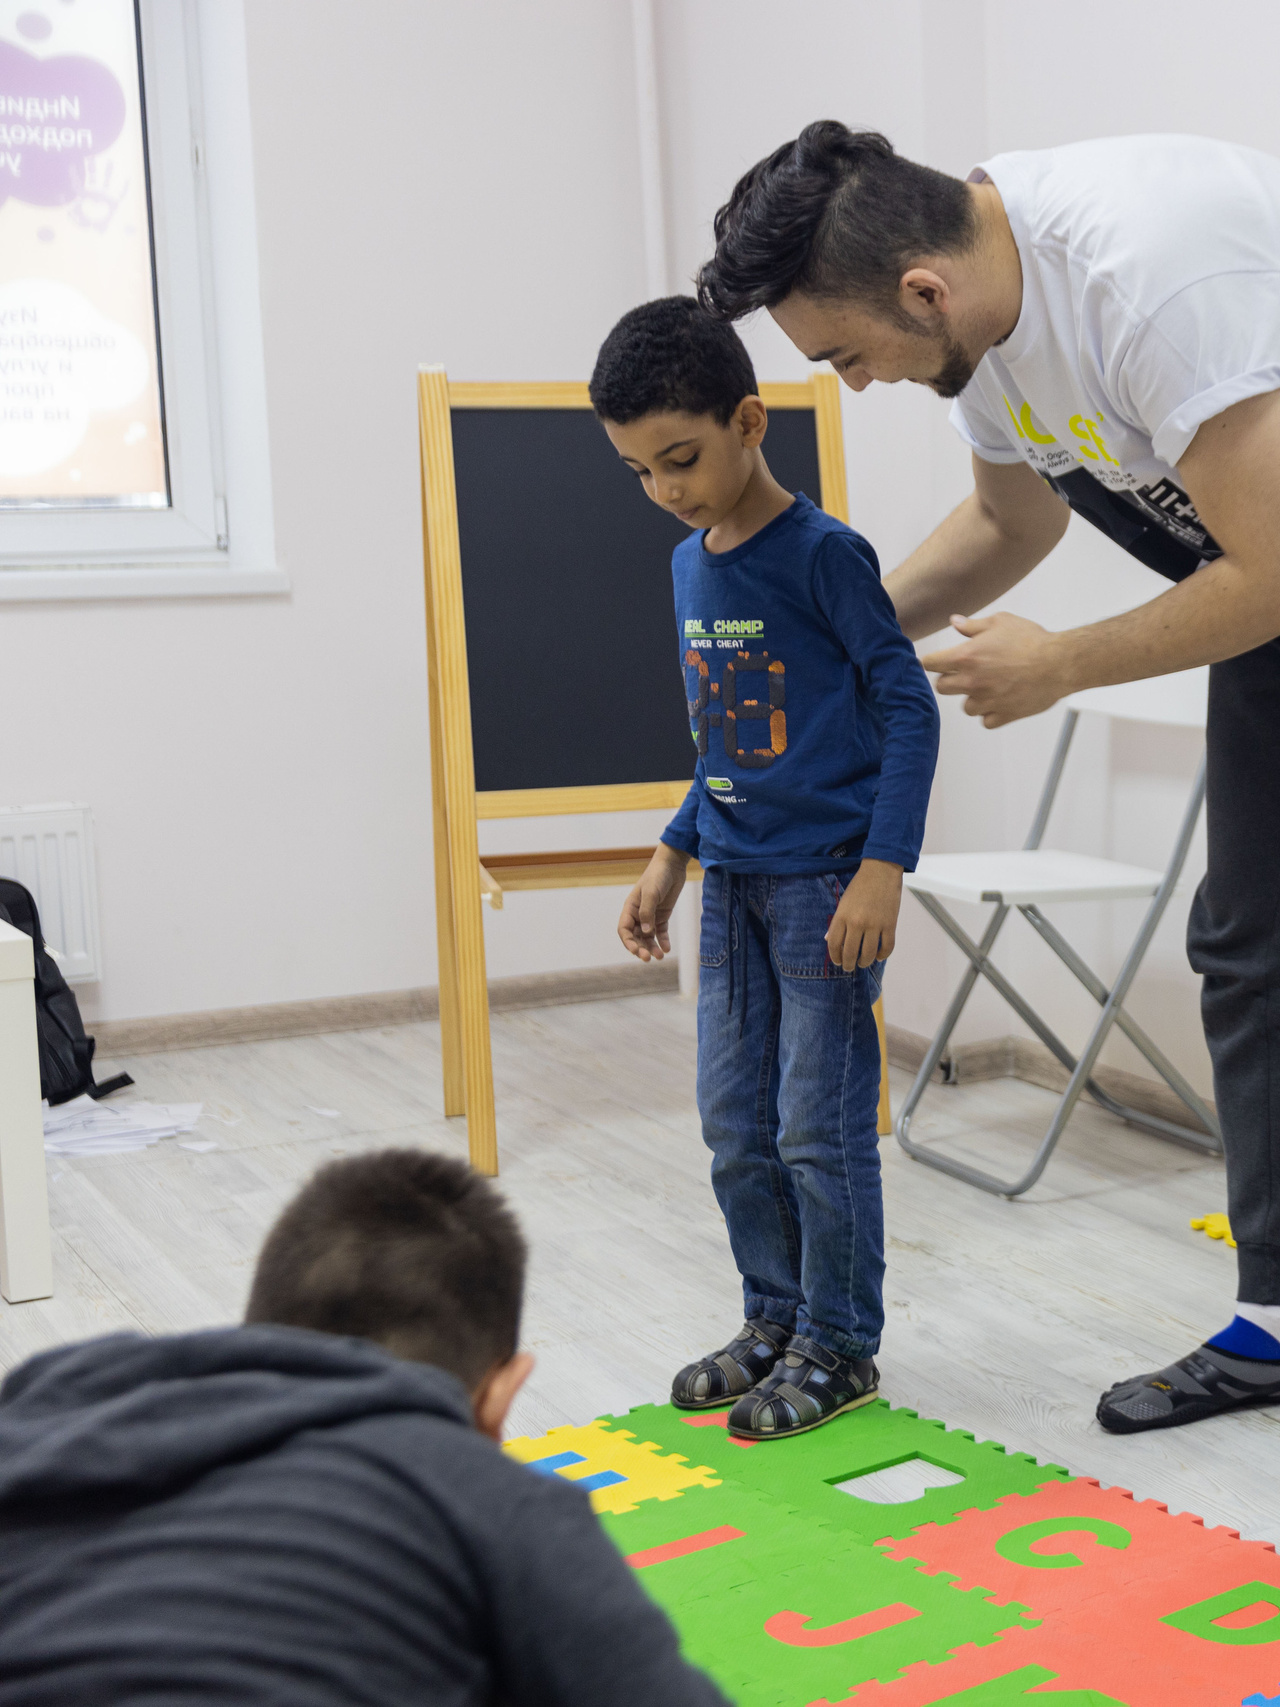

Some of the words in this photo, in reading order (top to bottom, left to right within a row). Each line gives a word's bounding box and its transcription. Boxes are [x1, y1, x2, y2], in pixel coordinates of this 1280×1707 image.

[713, 619, 764, 634] CHAMP
[716, 639, 744, 648] CHEAT
[995, 1516, 1132, 1570] C
[763, 1602, 924, 1648] J
